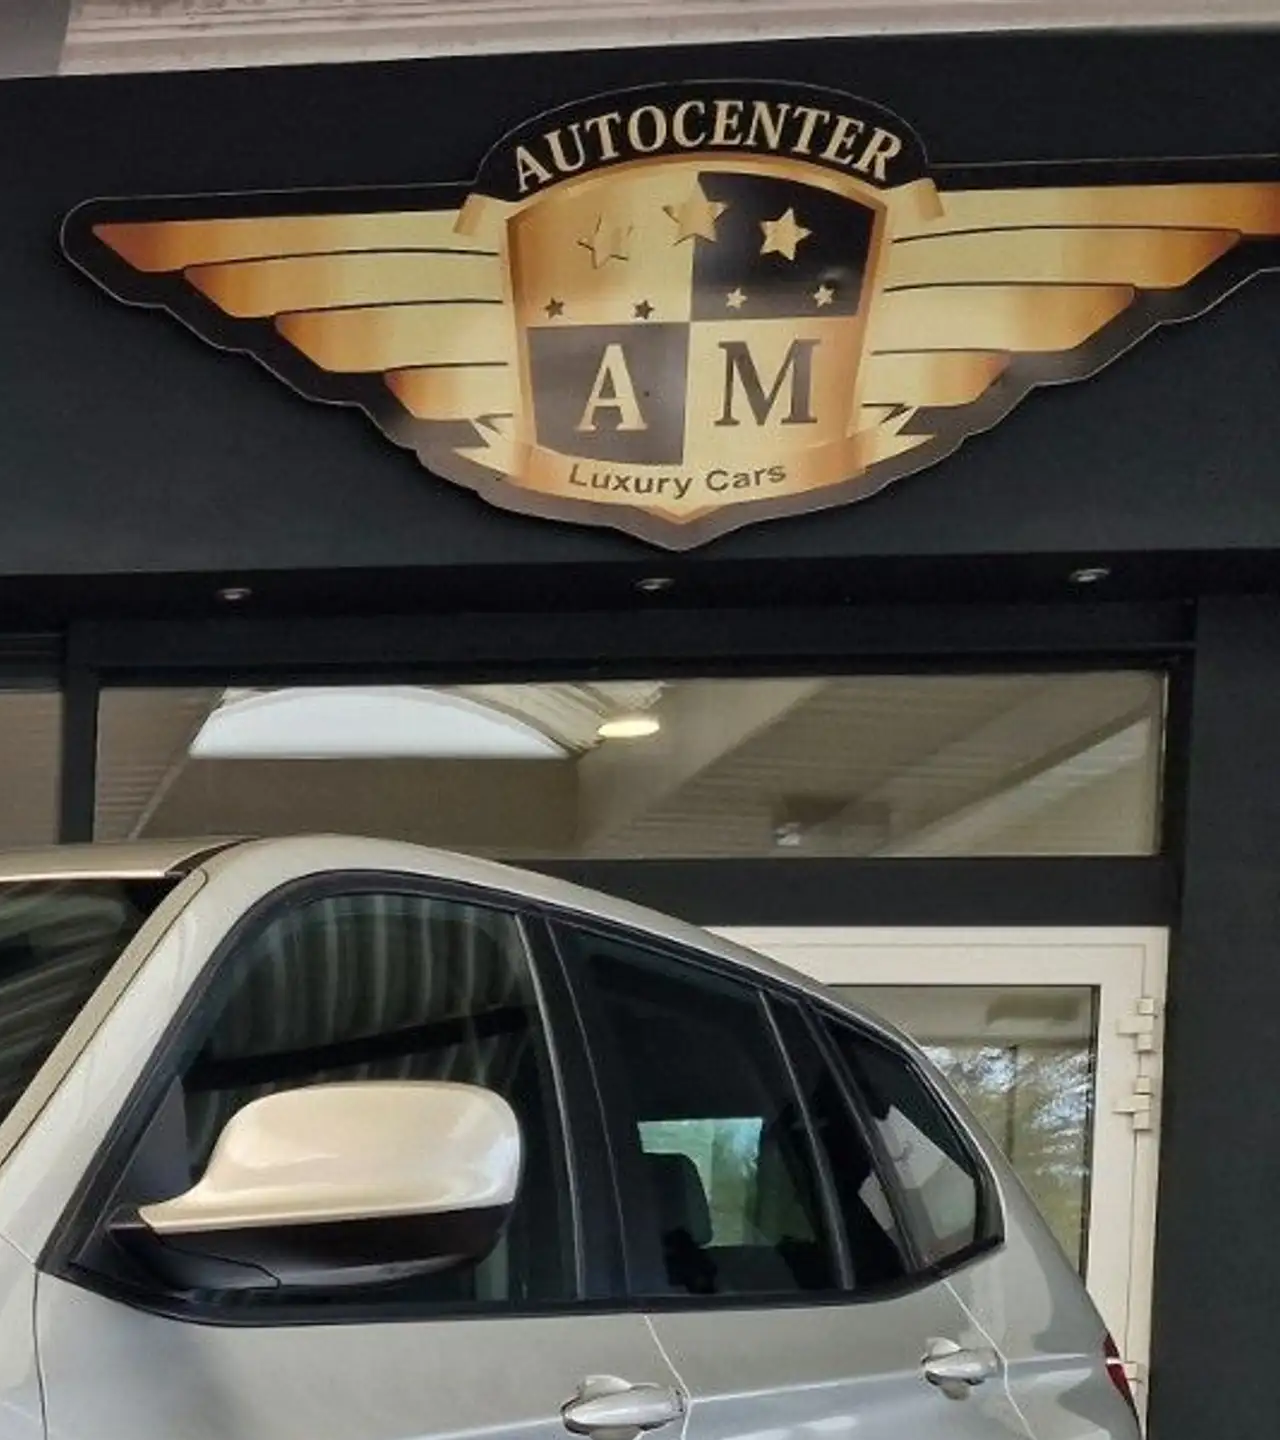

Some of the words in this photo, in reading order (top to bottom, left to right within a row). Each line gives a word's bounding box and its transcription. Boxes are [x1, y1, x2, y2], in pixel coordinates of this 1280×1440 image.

[512, 100, 903, 194] AUTOCENTER
[568, 463, 693, 500] Luxury
[706, 464, 787, 491] Cars
